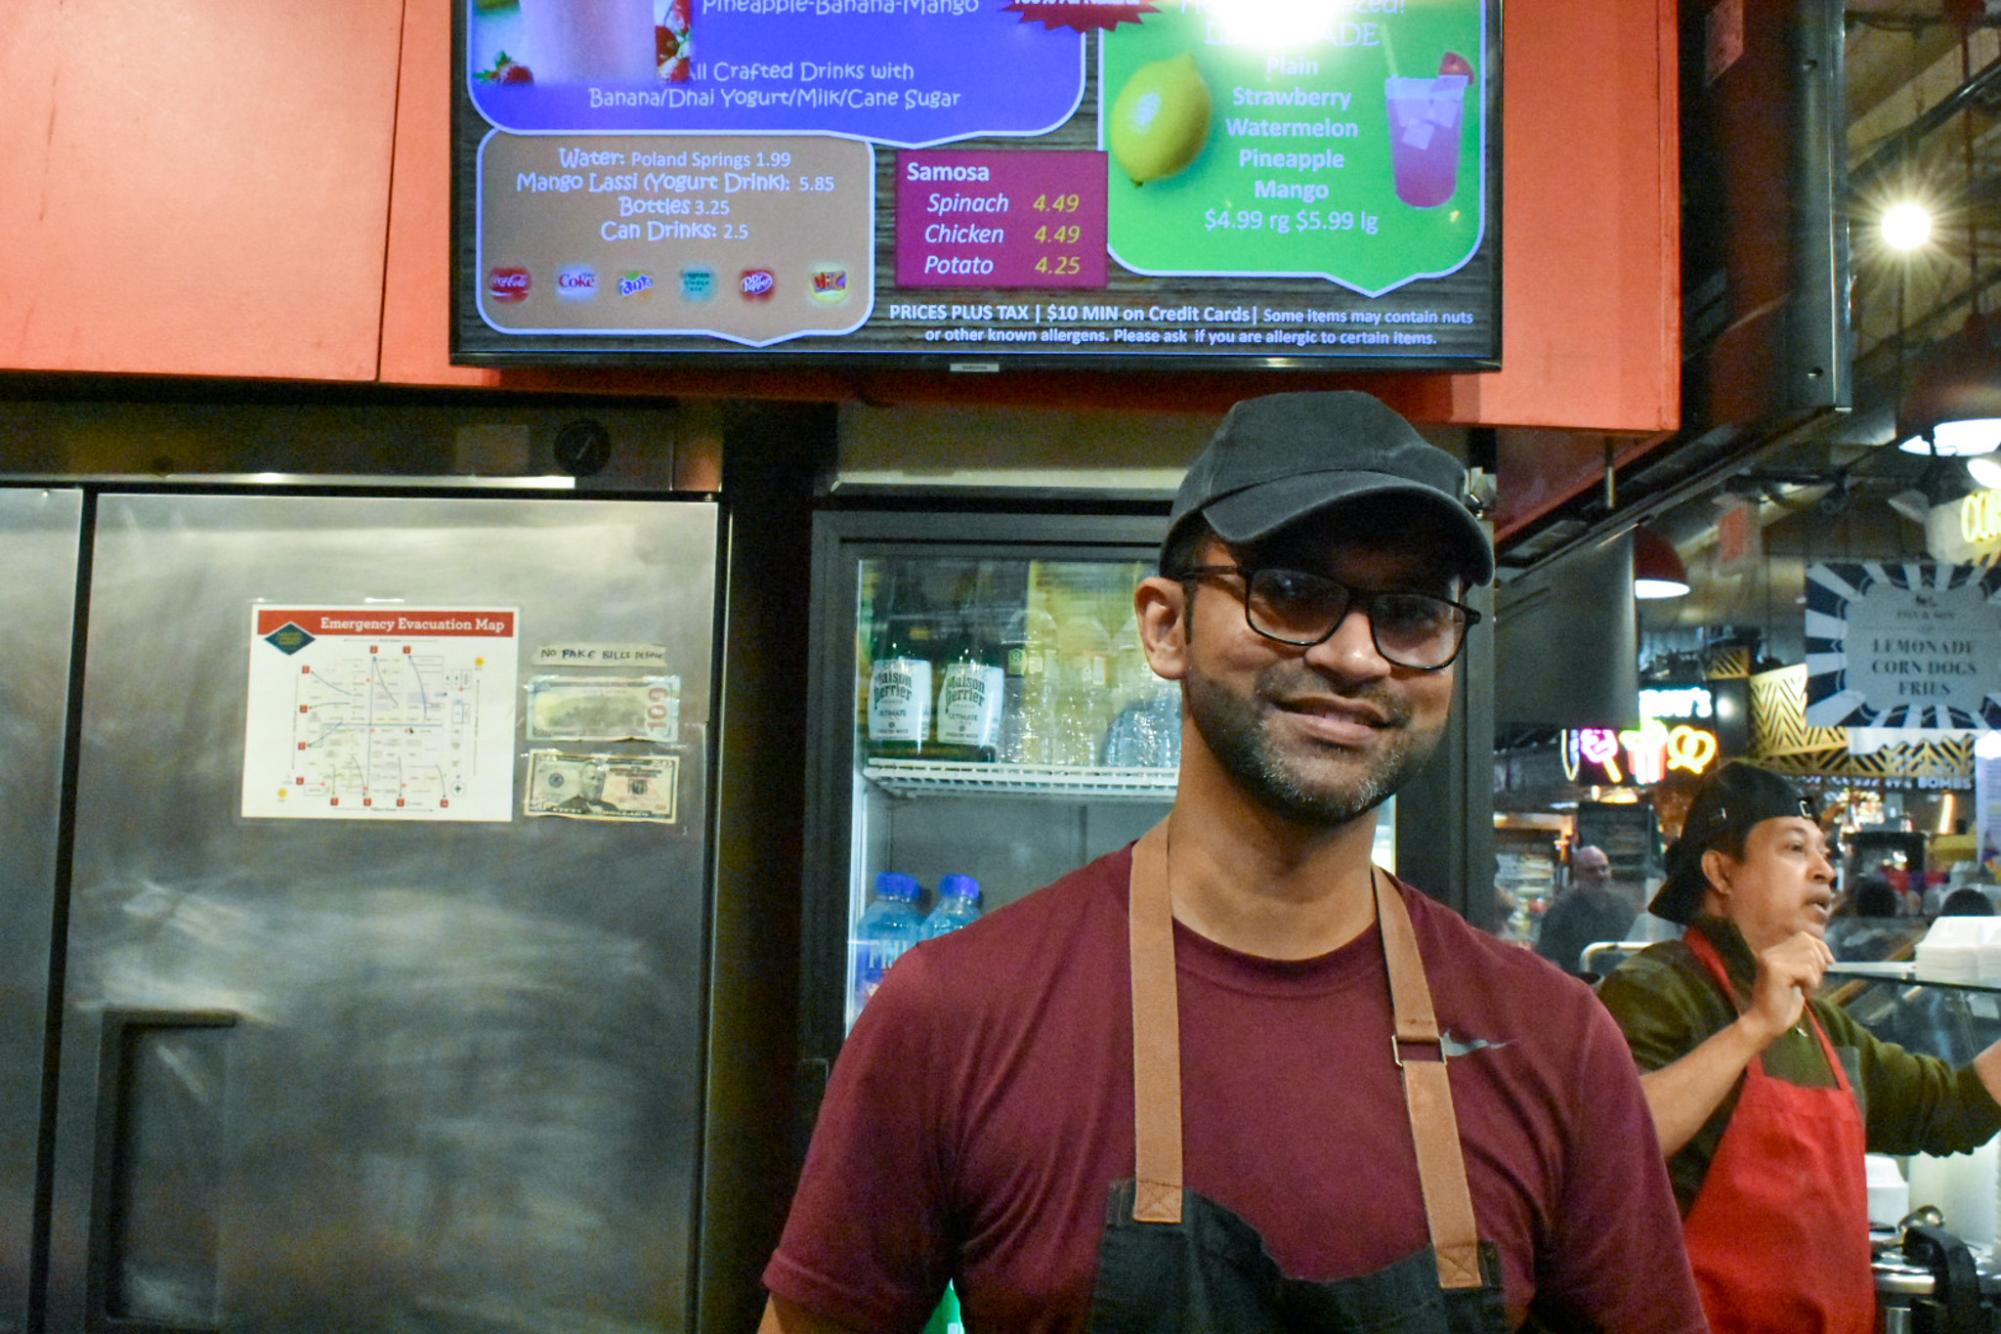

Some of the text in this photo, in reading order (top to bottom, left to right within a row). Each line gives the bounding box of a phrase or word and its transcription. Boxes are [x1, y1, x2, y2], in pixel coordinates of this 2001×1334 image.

[713, 61, 794, 81] Crafted
[800, 61, 865, 81] Drinks
[871, 62, 914, 81] with
[1266, 55, 1319, 76] Plain
[720, 88, 899, 110] Yogurt/Milk/Cane
[905, 89, 961, 110] Sugar
[1233, 86, 1352, 111] Strawberry
[1226, 118, 1358, 137] Watermelon
[558, 147, 791, 171] Water: Poland Springs 1.99
[1239, 148, 1345, 171] Pineapple
[907, 162, 990, 182] Samosa
[517, 172, 835, 194] Mango Lassi (Yogurt Drink): 5.85
[1254, 180, 1329, 204] Mango
[618, 195, 730, 217] Bottles 3.25
[926, 192, 1081, 216] Spinach 4.49
[600, 220, 749, 242] Can Drinks: 2.5
[1204, 208, 1263, 232] $4.99
[1269, 214, 1290, 234] rg
[1296, 208, 1354, 233] $5.99
[924, 224, 1082, 244] Chicken 4.49
[923, 254, 1082, 275] Potato 4.25
[889, 304, 947, 321] PRICES
[951, 304, 993, 321] PLUS
[996, 305, 1029, 321] TAX
[1046, 304, 1078, 323] $10
[1083, 306, 1119, 322] MIN
[1123, 309, 1144, 322] on
[1149, 305, 1200, 323] Credit
[1263, 308, 1304, 324] Some
[1307, 308, 1347, 324] items
[1351, 311, 1381, 328] may
[1385, 309, 1438, 324] contain
[1442, 311, 1474, 324] nuts
[924, 328, 1438, 347] or other known allergens. Please ask if you are allergic to certain items.
[320, 616, 505, 634] Emergency Evacuation Map
[1873, 637, 1974, 655] LEMONADE
[1871, 660, 1978, 676] CORN DOGS
[1898, 681, 1952, 697] FRIES
